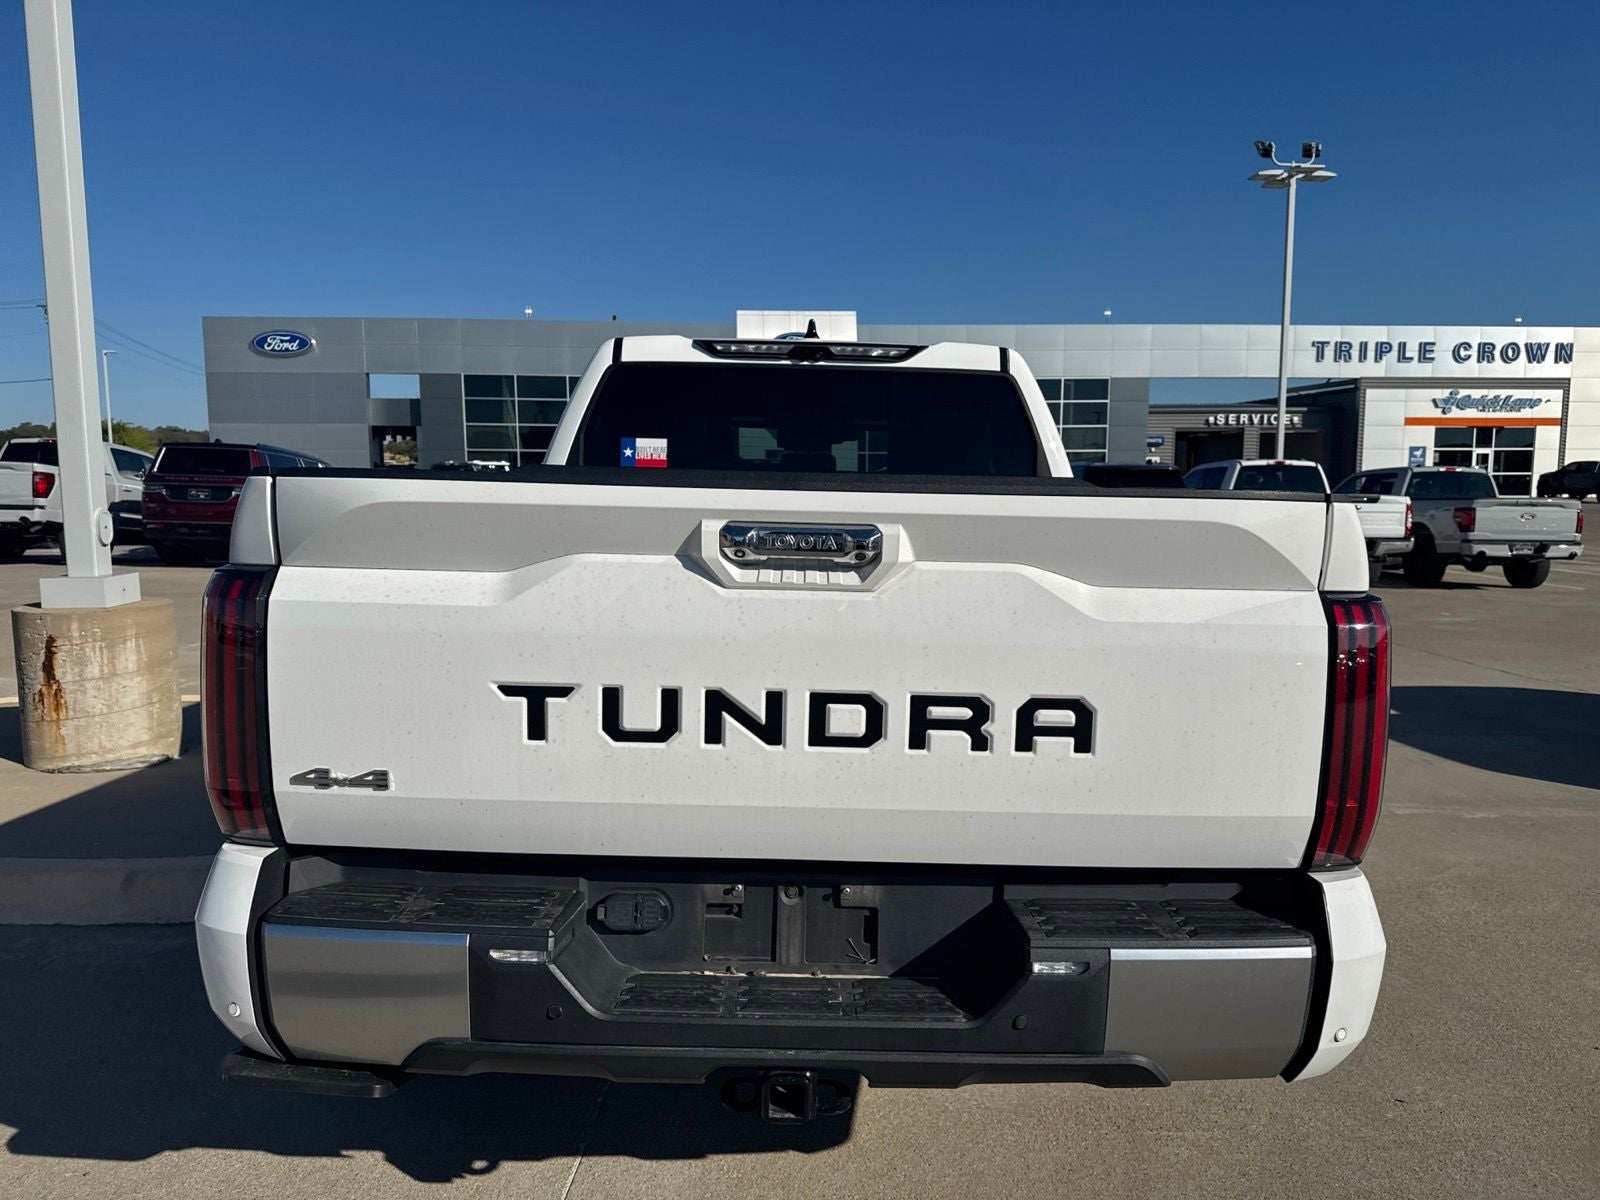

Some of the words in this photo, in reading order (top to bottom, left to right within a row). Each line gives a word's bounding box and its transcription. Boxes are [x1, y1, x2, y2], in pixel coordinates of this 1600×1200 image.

[264, 335, 300, 351] Ford
[1311, 340, 1437, 363] TRIPLE
[1451, 341, 1574, 364] CROWN
[1216, 413, 1291, 425] SERVICE
[764, 534, 838, 550] TOYOTA
[492, 683, 1096, 755] TUNDRA
